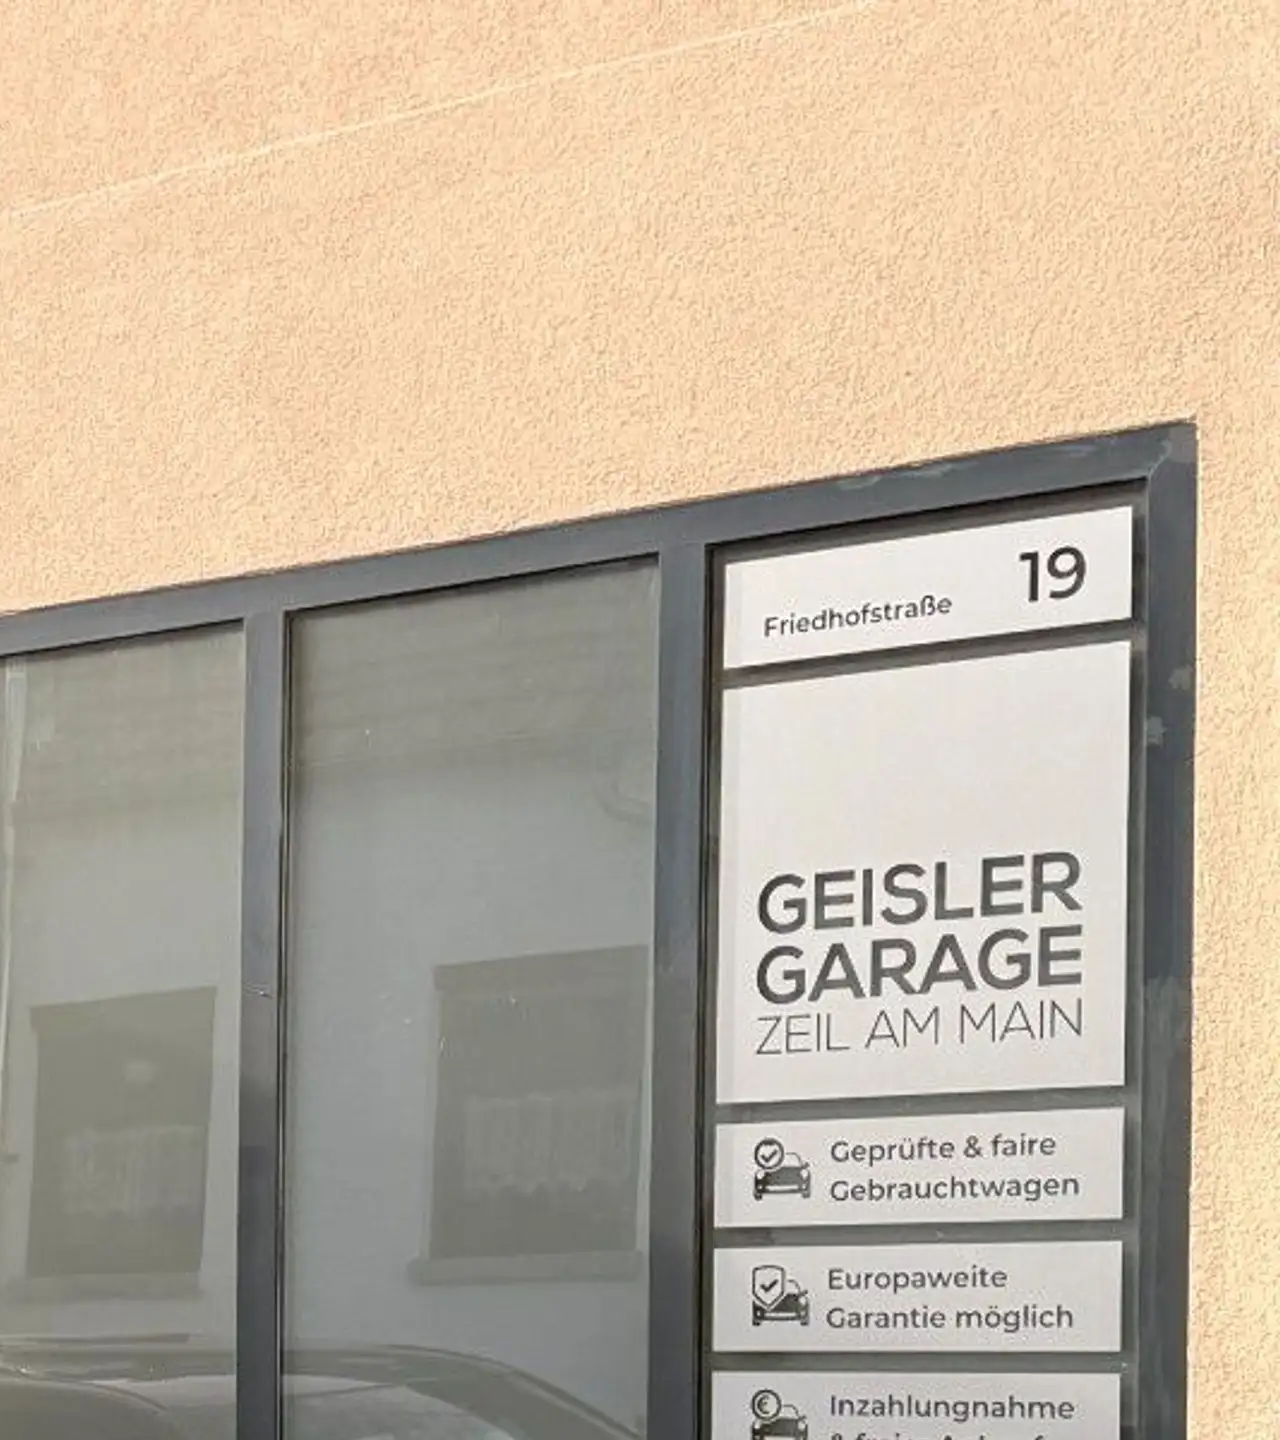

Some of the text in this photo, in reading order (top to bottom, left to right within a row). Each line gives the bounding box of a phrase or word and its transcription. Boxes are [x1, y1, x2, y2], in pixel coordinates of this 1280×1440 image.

[1020, 546, 1086, 602] 19
[764, 595, 953, 637] Friedhofstraße
[758, 852, 1082, 938] GEISLER
[757, 924, 1082, 1008] GARAGE
[756, 998, 1081, 1055] ZEIL AM MAIN
[831, 1133, 1056, 1167] Geprüfte & faire
[831, 1176, 1079, 1201] Gebrauchtwagen
[829, 1265, 1007, 1294] Europaweite
[826, 1304, 1072, 1333] Garantie möglich
[831, 1394, 1074, 1423] Inzahlungnahme
